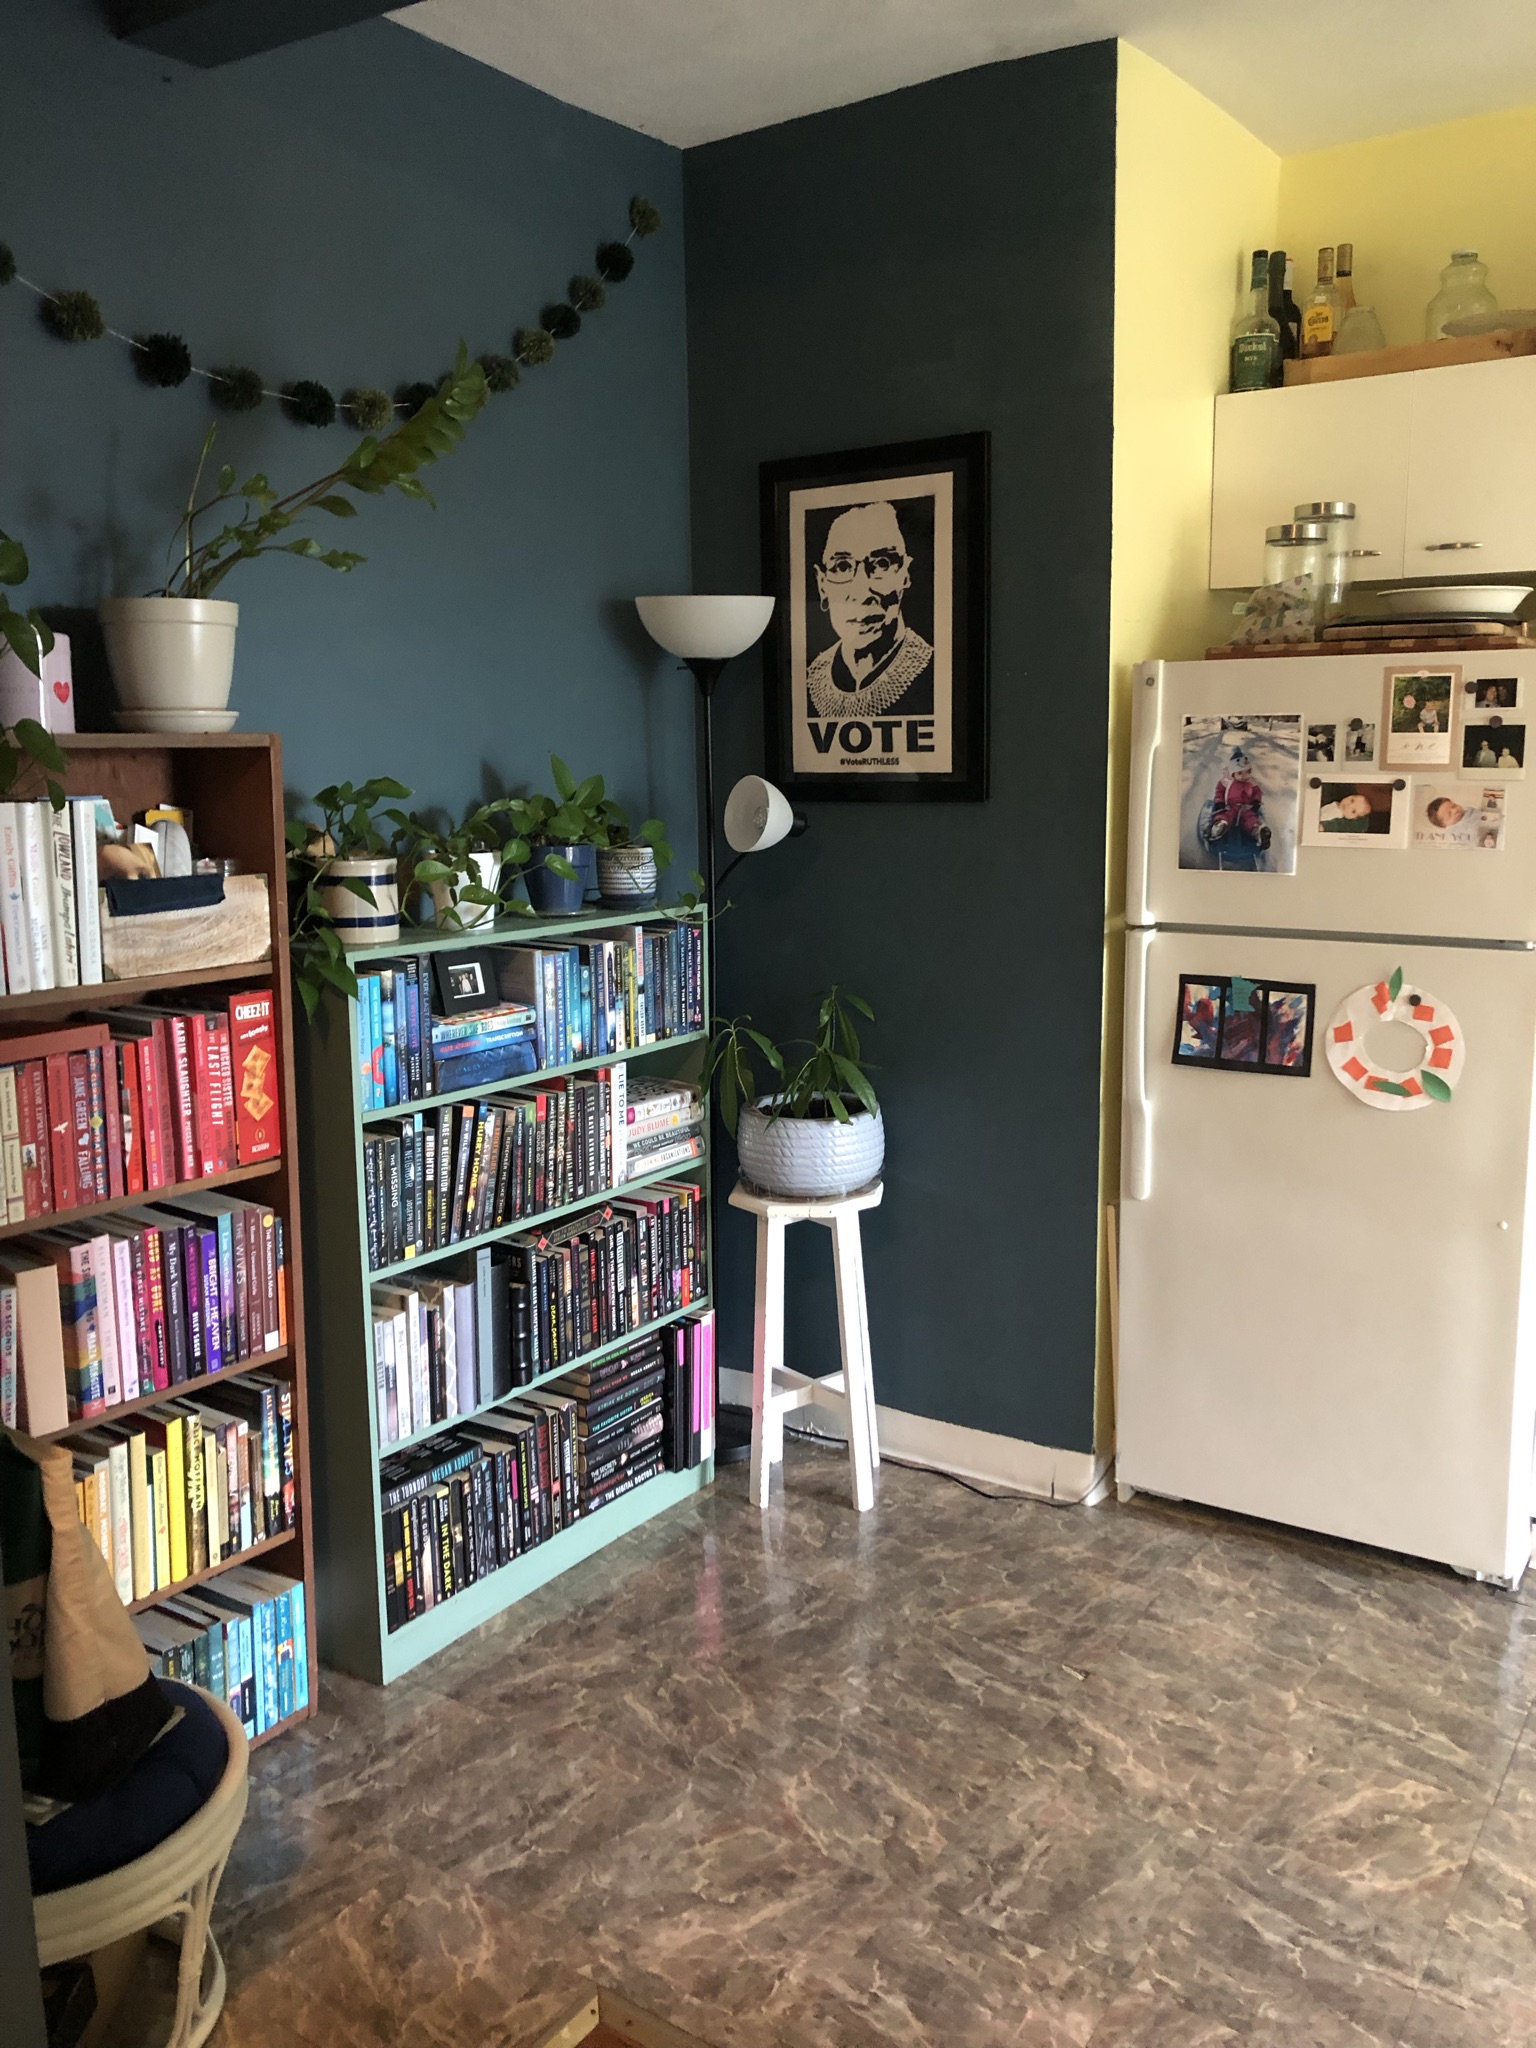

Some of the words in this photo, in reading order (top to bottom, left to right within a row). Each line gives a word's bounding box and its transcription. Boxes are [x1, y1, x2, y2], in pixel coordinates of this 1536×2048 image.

[807, 720, 935, 754] VOTE
[839, 757, 900, 766] #VoteRUTHLESS
[52, 811, 63, 828] THE
[53, 830, 72, 881] LOWLAND
[59, 885, 72, 929] Jhumpa
[63, 931, 76, 964] Lahiri
[235, 1001, 270, 1021] CHEEZ-IT
[175, 1021, 187, 1055] KARIN
[440, 1027, 467, 1041] WHEREVER
[468, 1024, 479, 1035] SHE
[481, 1020, 494, 1032] GOES
[485, 1030, 524, 1044] TRANSCRIPTION
[207, 1045, 220, 1076] LAST
[32, 1071, 42, 1105] ELINOR
[73, 1076, 86, 1098] JANE
[178, 1057, 191, 1117] SLAUGHTER
[198, 1069, 208, 1094] LIES
[200, 1098, 209, 1123] SHE
[210, 1082, 224, 1126] FLIGHT
[558, 1096, 565, 1112] ON
[618, 1093, 625, 1107] TO
[35, 1107, 45, 1141] LIPMAN
[75, 1100, 88, 1130] GREEN
[557, 1114, 565, 1134] THE
[618, 1109, 625, 1126] ME
[629, 1125, 646, 1137] JUDY
[646, 1117, 670, 1131] BLUME
[94, 1128, 102, 1153] WHAT
[184, 1120, 193, 1143] PIECES
[202, 1127, 211, 1156] TOLD
[474, 1121, 485, 1156] HURRY
[641, 1138, 658, 1146] COULD
[665, 1126, 690, 1139] BEAUTIFUL
[186, 1144, 193, 1153] OF
[187, 1154, 195, 1168] HER
[425, 1135, 435, 1181] BRIGHTON
[502, 1136, 511, 1170] REMEMBER
[557, 1136, 565, 1162] EDGE
[660, 1147, 691, 1162] ORGANIZATIONS
[77, 1150, 93, 1188] FALLING
[96, 1157, 103, 1170] WE
[459, 1152, 467, 1183] REMEMBER
[470, 1157, 480, 1188] HOME
[96, 1172, 105, 1195] LOSE
[390, 1167, 399, 1208] MISSING
[458, 1184, 467, 1196] ME
[235, 1222, 243, 1240] THE
[406, 1221, 414, 1242] SOUZA
[616, 1231, 624, 1246] TO
[147, 1233, 159, 1263] GOOD
[167, 1242, 176, 1256] My
[616, 1245, 624, 1264] THE
[149, 1267, 160, 1282] AS
[169, 1257, 178, 1280] Dark
[235, 1244, 246, 1285] WIVES
[617, 1263, 625, 1292] LIONS
[5, 1293, 13, 1311] 180
[150, 1285, 163, 1314] GONE
[171, 1281, 179, 1315] Vanessa
[203, 1295, 211, 1328] MEISSNER
[138, 1297, 147, 1333] MISTAKE
[5, 1314, 13, 1357] SECONDS
[86, 1331, 97, 1359] MAAZA
[88, 1359, 101, 1400] MENGISTE
[376, 1360, 385, 1390] BETTER
[630, 1367, 643, 1377] MEGAN
[643, 1360, 657, 1371] ABBOTT
[5, 1368, 13, 1400] JESSICA
[5, 1401, 13, 1423] PARK
[280, 1392, 292, 1431] STILL
[597, 1399, 615, 1411] STRIKE
[624, 1387, 639, 1397] DOWN
[592, 1424, 600, 1432] THE
[600, 1414, 619, 1427] FAVORITE
[619, 1405, 633, 1417] SISTER
[192, 1421, 200, 1451] ALICE
[538, 1424, 548, 1449] BAD
[282, 1433, 294, 1476] LIVES
[431, 1462, 453, 1484] MEGAN
[454, 1450, 474, 1472] ABBOTT
[590, 1467, 600, 1478] THE
[599, 1458, 617, 1475] SECRETS
[193, 1455, 202, 1509] HOFFMAN
[539, 1451, 549, 1489] BLOOD
[388, 1489, 400, 1507] THE
[401, 1474, 428, 1500] TURNOUT
[604, 1489, 615, 1501] THE
[615, 1480, 634, 1496] DIGITAL
[634, 1468, 653, 1485] DOCTOR
[411, 1500, 419, 1551] Complications
[441, 1523, 450, 1537] IN
[441, 1538, 451, 1560] THE
[443, 1561, 452, 1592] DARK
